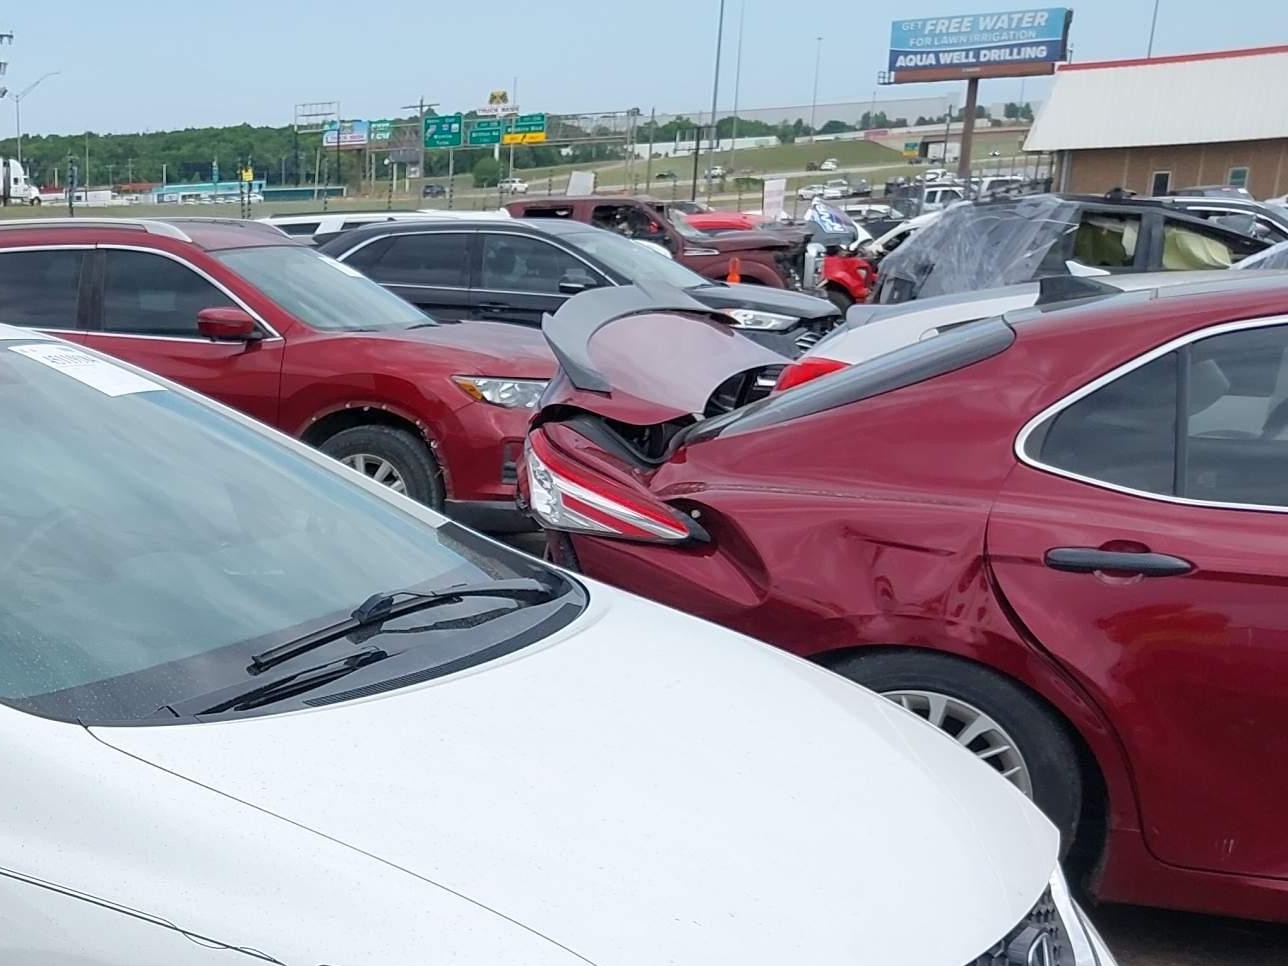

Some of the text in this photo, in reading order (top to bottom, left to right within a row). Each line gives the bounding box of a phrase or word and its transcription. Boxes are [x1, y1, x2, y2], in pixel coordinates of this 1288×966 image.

[902, 11, 1049, 35] GET FREE WATER
[909, 30, 1037, 47] FOR LAWN IRRIGATION
[895, 46, 1048, 67] AQUA WELL DRILLING
